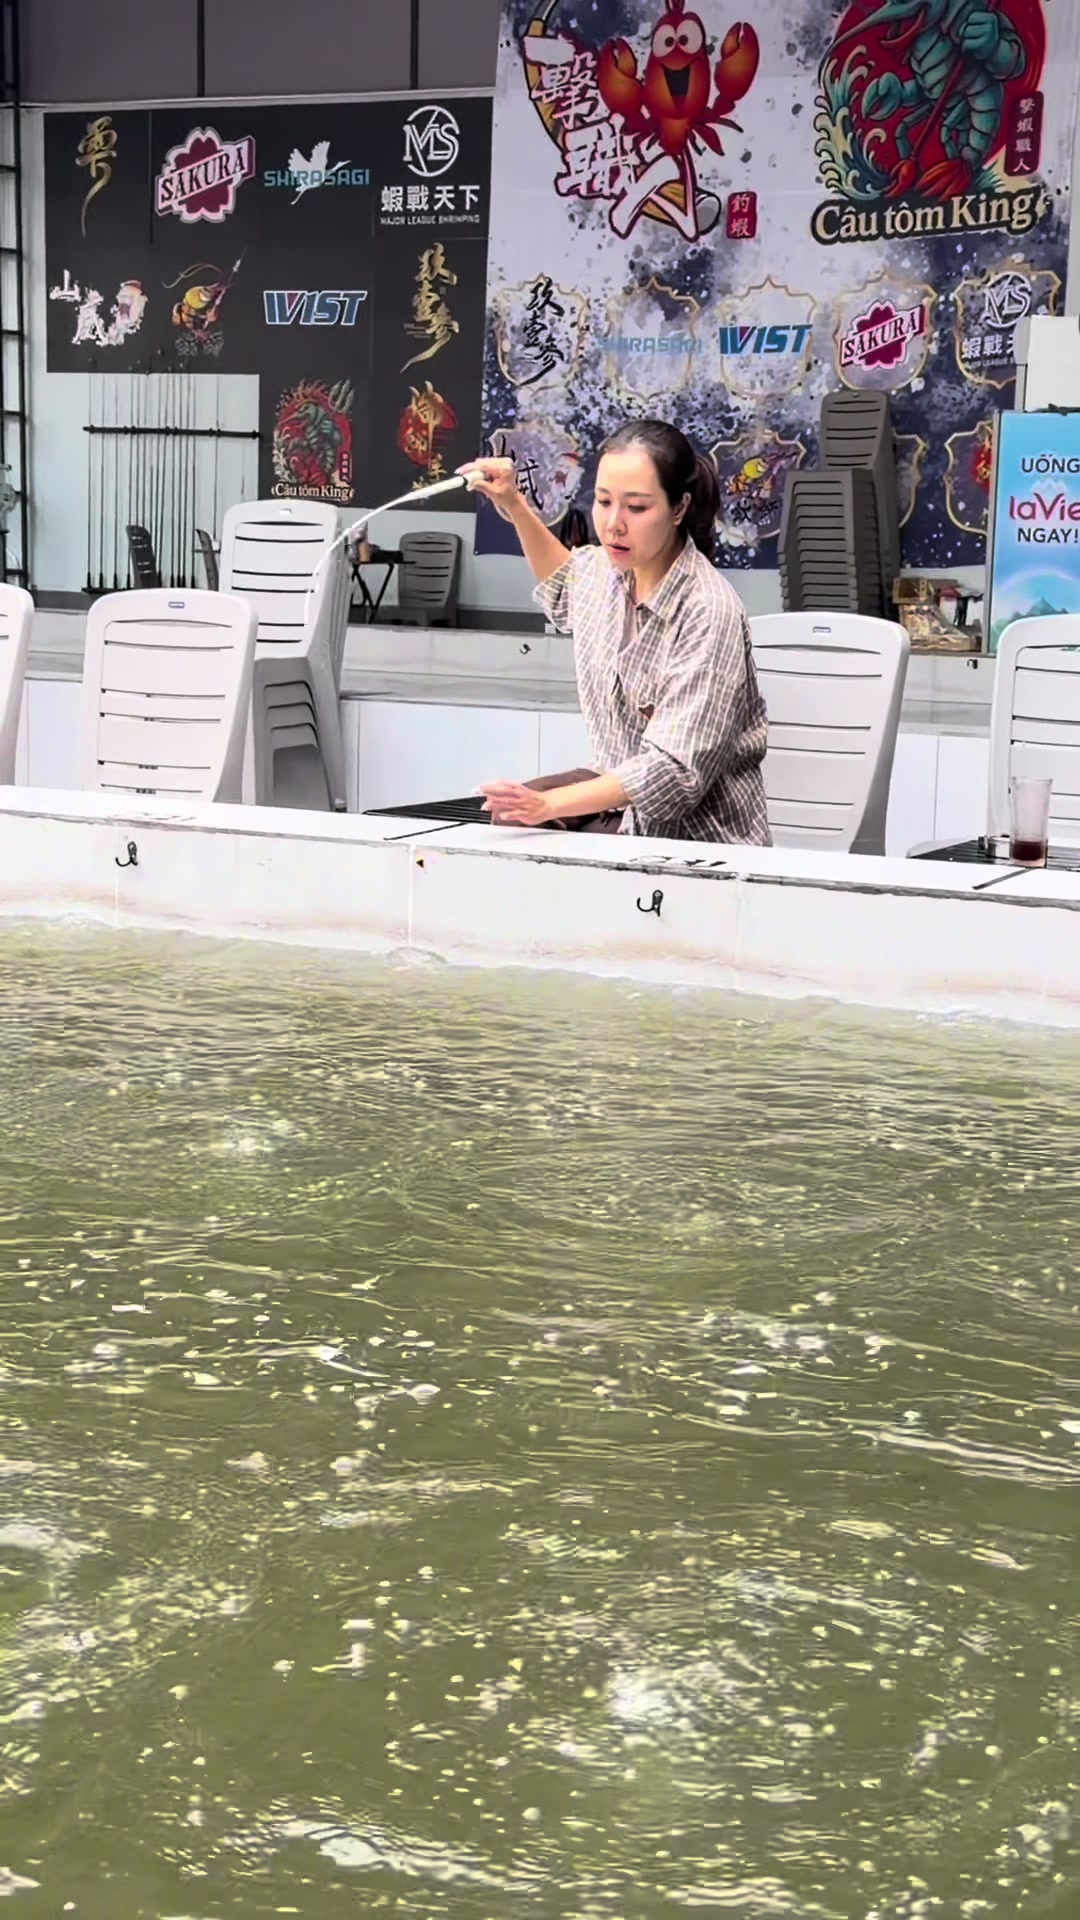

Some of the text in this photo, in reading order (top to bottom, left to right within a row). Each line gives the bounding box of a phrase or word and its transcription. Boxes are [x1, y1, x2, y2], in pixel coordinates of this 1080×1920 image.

[161, 146, 246, 204] SAKURA
[264, 168, 370, 187] SHIRASAGI
[381, 185, 480, 212] 蝦戰天下
[730, 194, 751, 237] 釣蝦
[815, 193, 1034, 240] Câu tôm King
[843, 311, 918, 360] SAKURA
[1021, 453, 1080, 473] UỐNG
[275, 483, 297, 497] Câu
[321, 485, 350, 501] King
[1009, 492, 1080, 521] laVie
[1018, 527, 1079, 543] NGAY!
